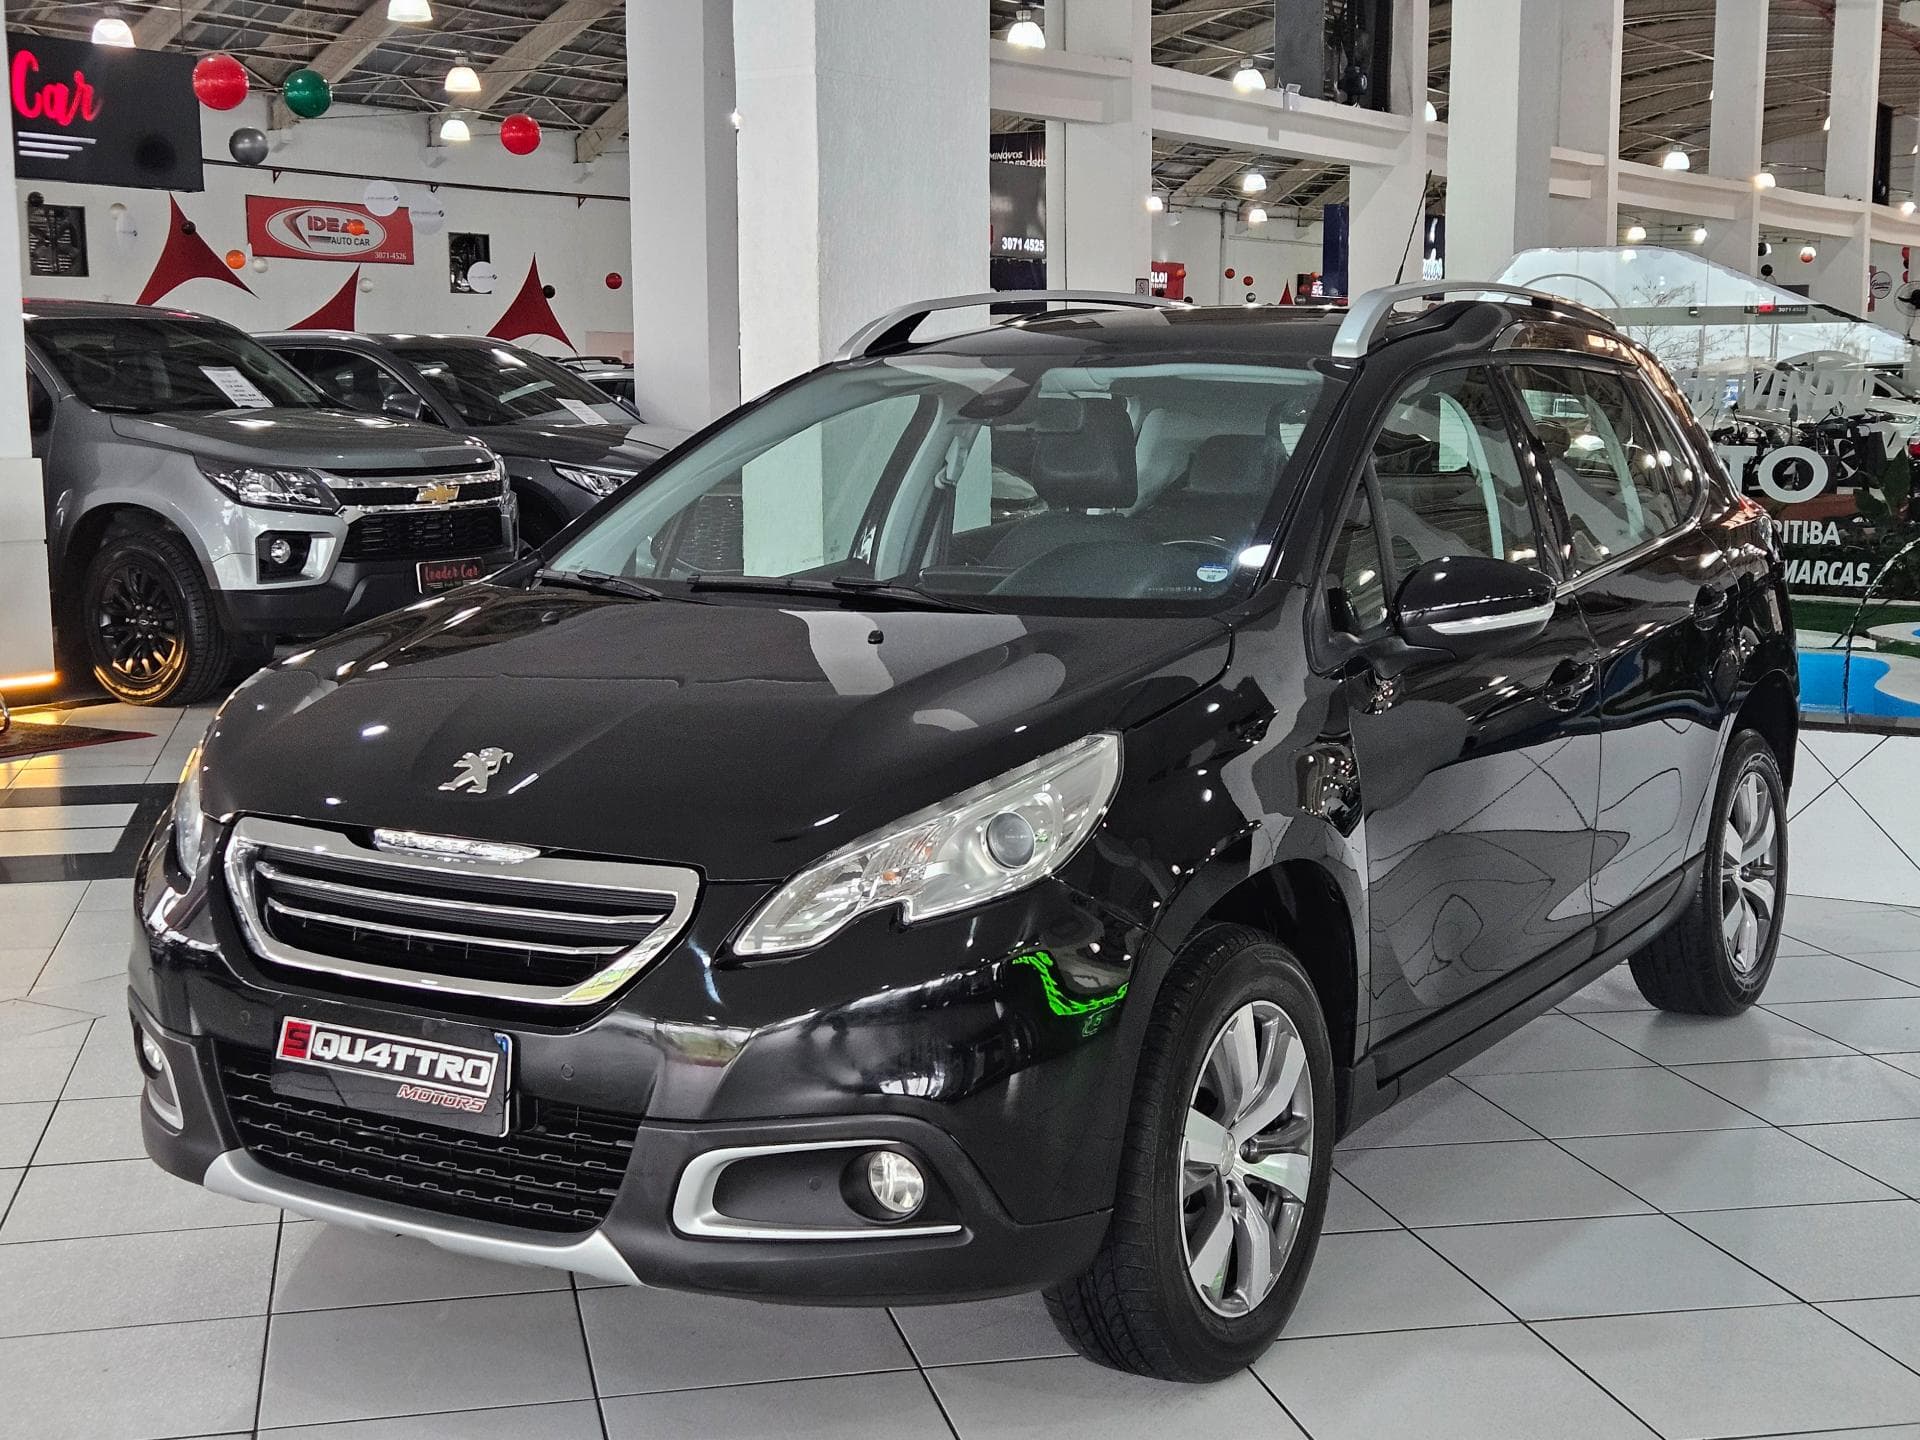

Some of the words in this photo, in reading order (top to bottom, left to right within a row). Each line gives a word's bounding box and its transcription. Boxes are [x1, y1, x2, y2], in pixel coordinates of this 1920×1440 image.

[11, 50, 102, 125] Car
[331, 236, 352, 246] AUTO
[354, 237, 370, 247] CAR
[1002, 237, 1022, 250] 3071
[1024, 238, 1044, 252] 4525
[397, 1084, 488, 1113] MOTORS
